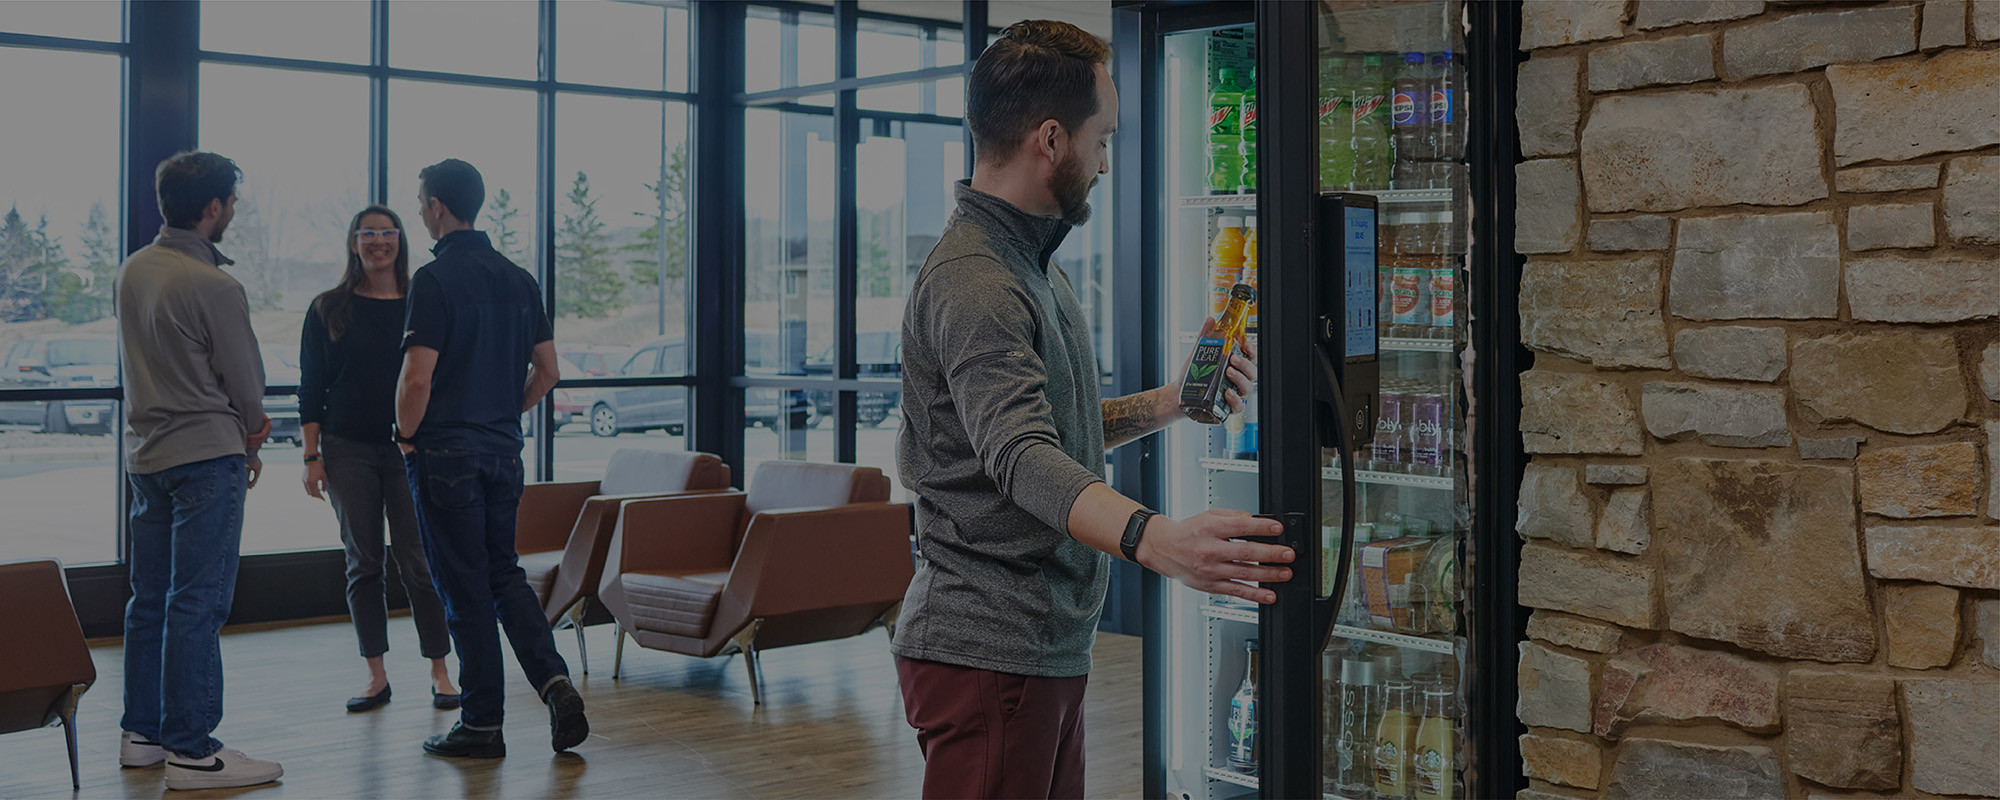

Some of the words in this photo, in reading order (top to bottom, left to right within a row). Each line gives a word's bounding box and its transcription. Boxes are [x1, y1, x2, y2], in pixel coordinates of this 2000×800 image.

[1198, 345, 1220, 354] PURE
[1195, 353, 1217, 362] LEAF
[1418, 418, 1439, 436] bly
[1343, 689, 1355, 771] VOSS
